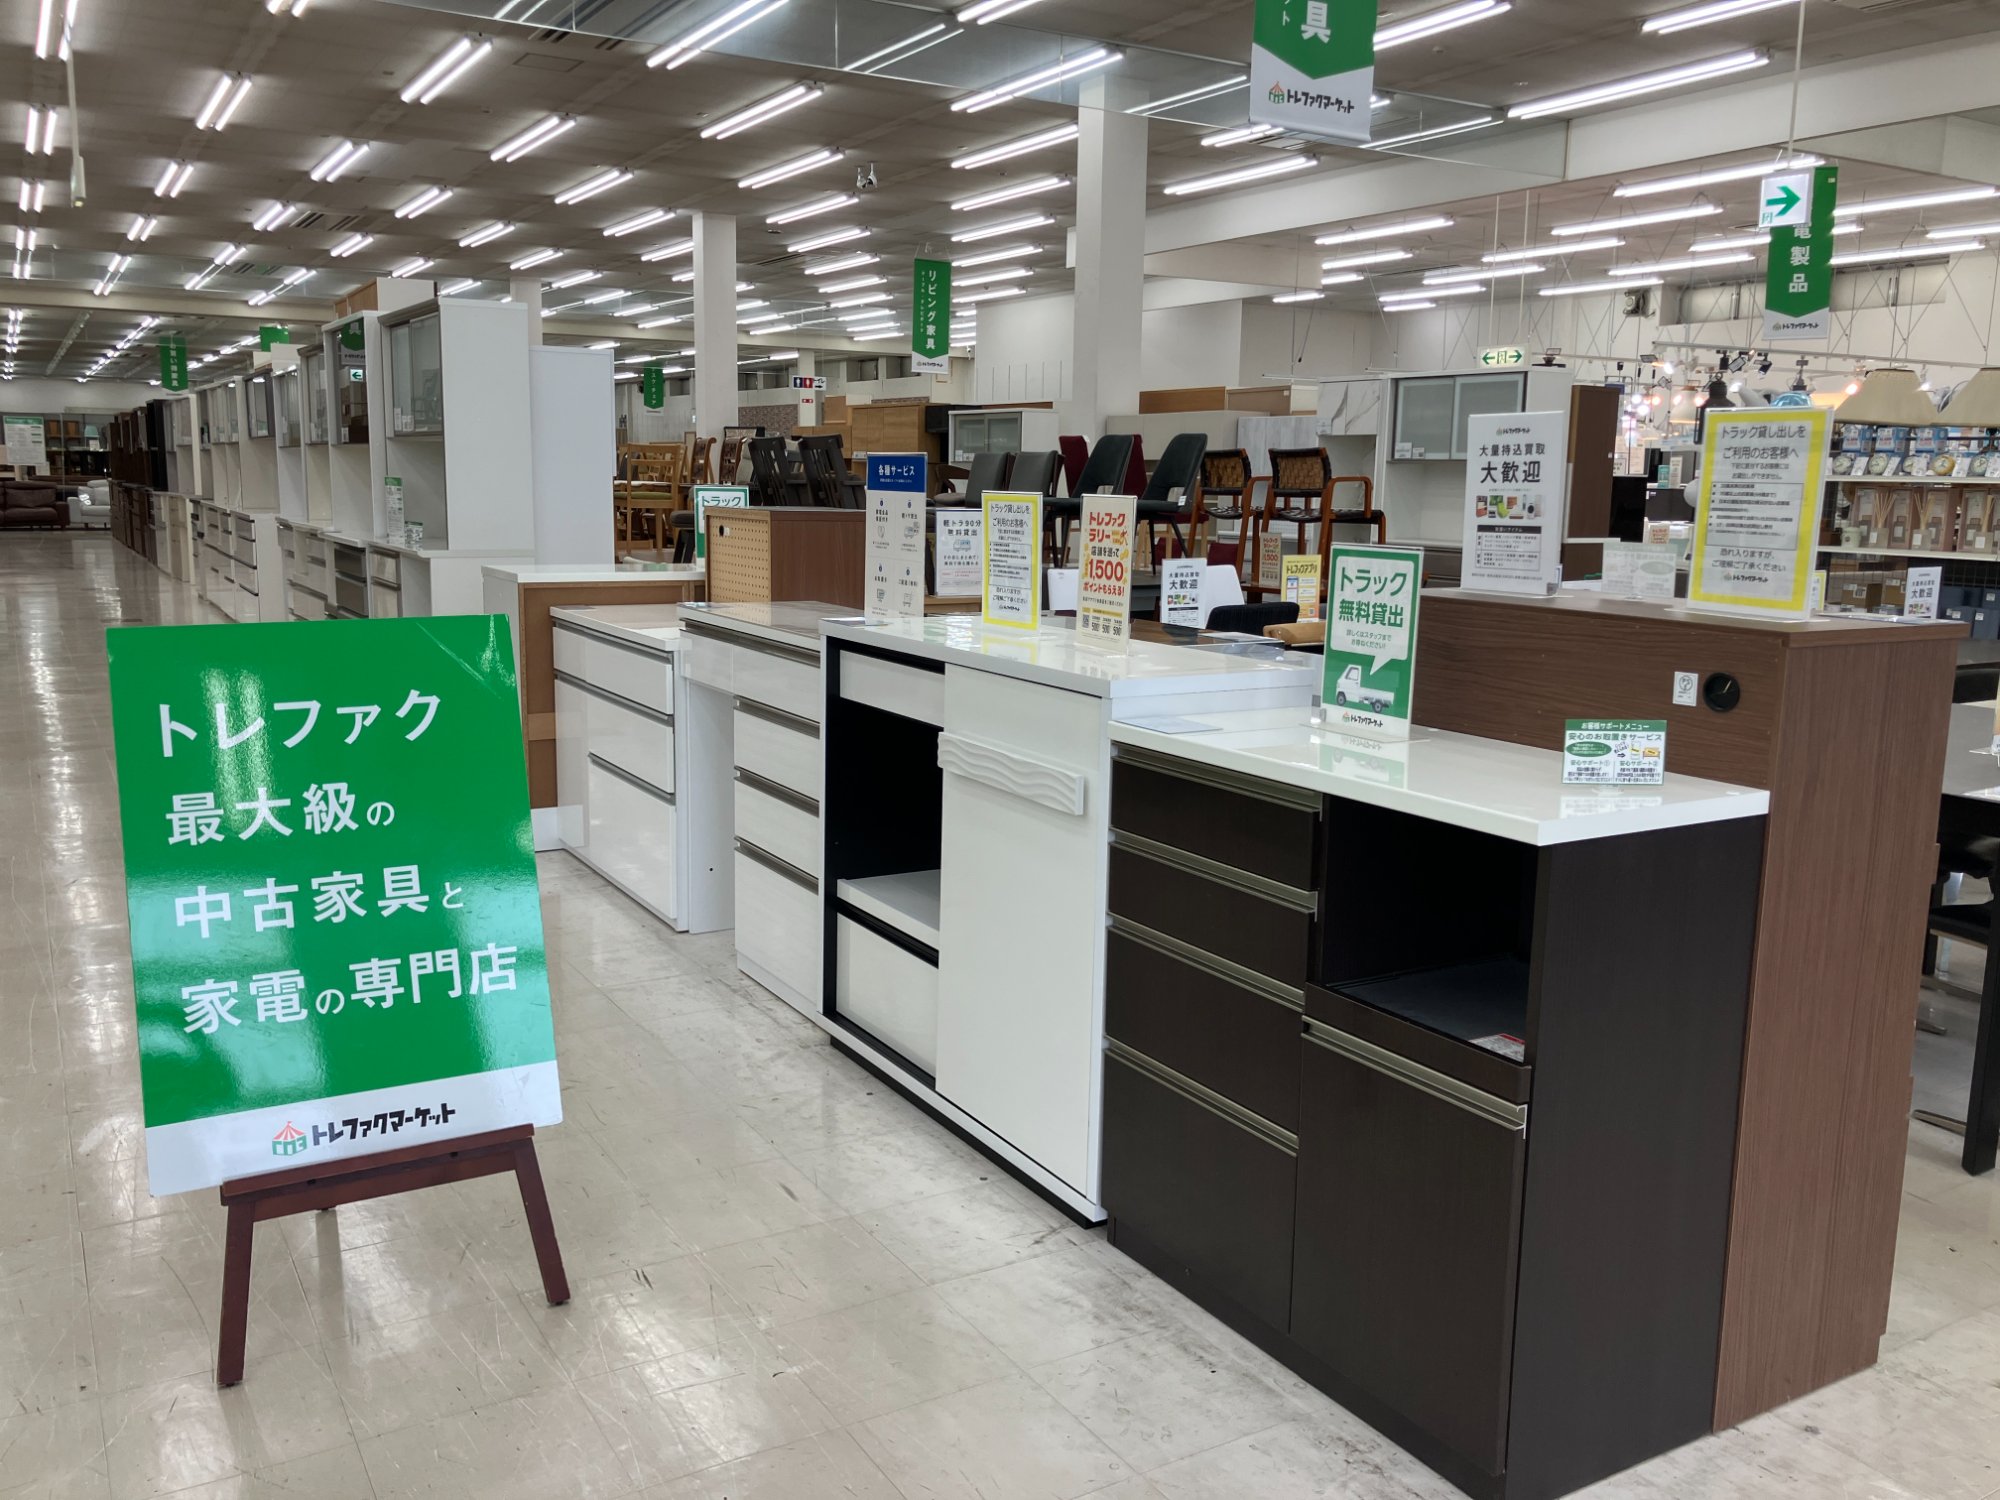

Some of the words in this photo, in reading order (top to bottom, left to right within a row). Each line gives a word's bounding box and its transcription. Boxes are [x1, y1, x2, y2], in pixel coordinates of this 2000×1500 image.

[1301, 0, 1331, 43] 具
[1286, 88, 1355, 114] トレファクマーケット
[925, 270, 937, 350] リビング家具
[1721, 425, 1807, 439] トラック貸し出しを
[1479, 443, 1546, 457] 大量持込買取
[1723, 446, 1799, 460] ご利用のお客様へ
[878, 464, 915, 476] 各種サービス
[1480, 460, 1541, 484] 大歓迎
[991, 503, 1030, 514] トラック貸し出しを
[992, 517, 1029, 528] ご利用のお客様へ
[1089, 512, 1125, 527] トレファク
[1089, 528, 1110, 543] ラリー
[1091, 546, 1120, 558] 店舗を巡って
[1089, 558, 1124, 582] 1,500
[1711, 559, 1787, 572] ご理解ご了承ください
[1169, 579, 1198, 590] 大歓迎
[1340, 566, 1408, 596] トラック
[1911, 587, 1933, 599] 大歓迎
[1338, 599, 1404, 628] 無料貸出
[1346, 629, 1392, 641] 詳しくはスタッフまで
[157, 688, 443, 759] トレファク
[1350, 715, 1383, 728] トレファクマーケット
[1568, 732, 1662, 741] 安心のお取置きサービス
[165, 780, 396, 848] 最大級の
[174, 863, 465, 940] 中古家具と
[180, 941, 520, 1039] 家電の専門店
[312, 1102, 456, 1148] トレファクマーケット
